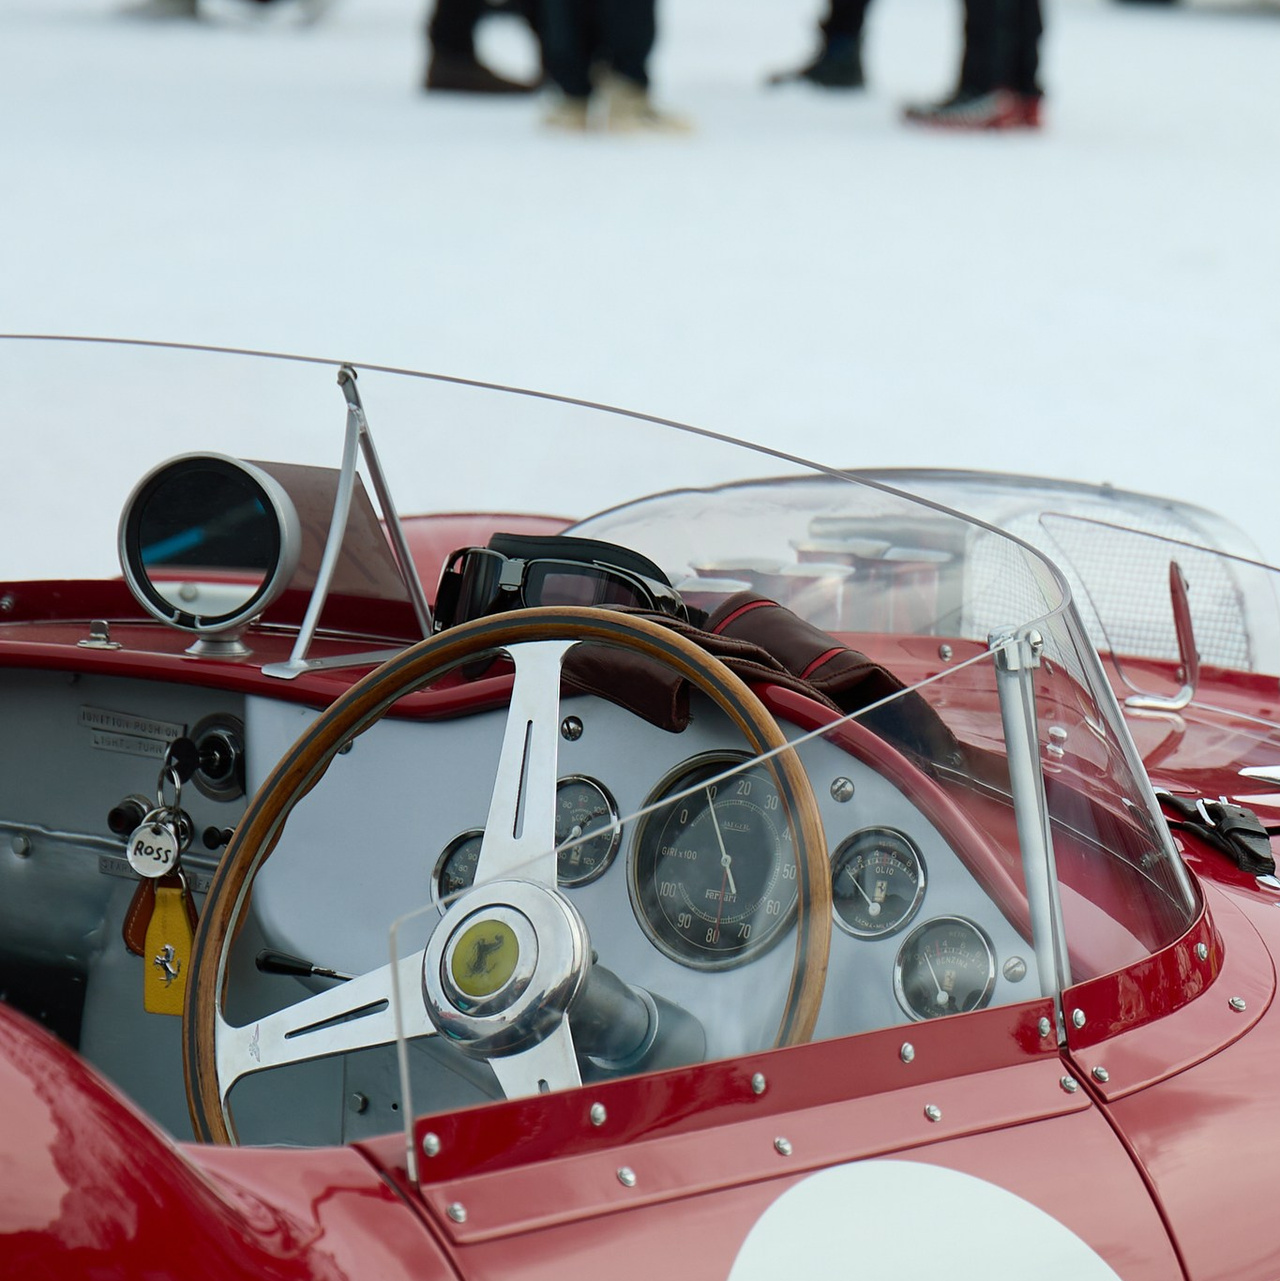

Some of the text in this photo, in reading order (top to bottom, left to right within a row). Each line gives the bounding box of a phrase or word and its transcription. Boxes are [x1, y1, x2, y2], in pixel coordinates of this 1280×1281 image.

[82, 711, 178, 738] IGNITION PUSH ON
[138, 741, 163, 754] TURN
[737, 780, 751, 796] 20
[764, 795, 779, 810] 30
[661, 846, 678, 857] GIRI
[782, 863, 796, 880] 50
[875, 866, 894, 876] OLIO
[659, 881, 676, 898] 100
[765, 899, 780, 915] 60
[677, 912, 692, 929] 90
[706, 927, 720, 944] 80
[737, 922, 751, 939] 70
[935, 955, 968, 969] BENZINA
